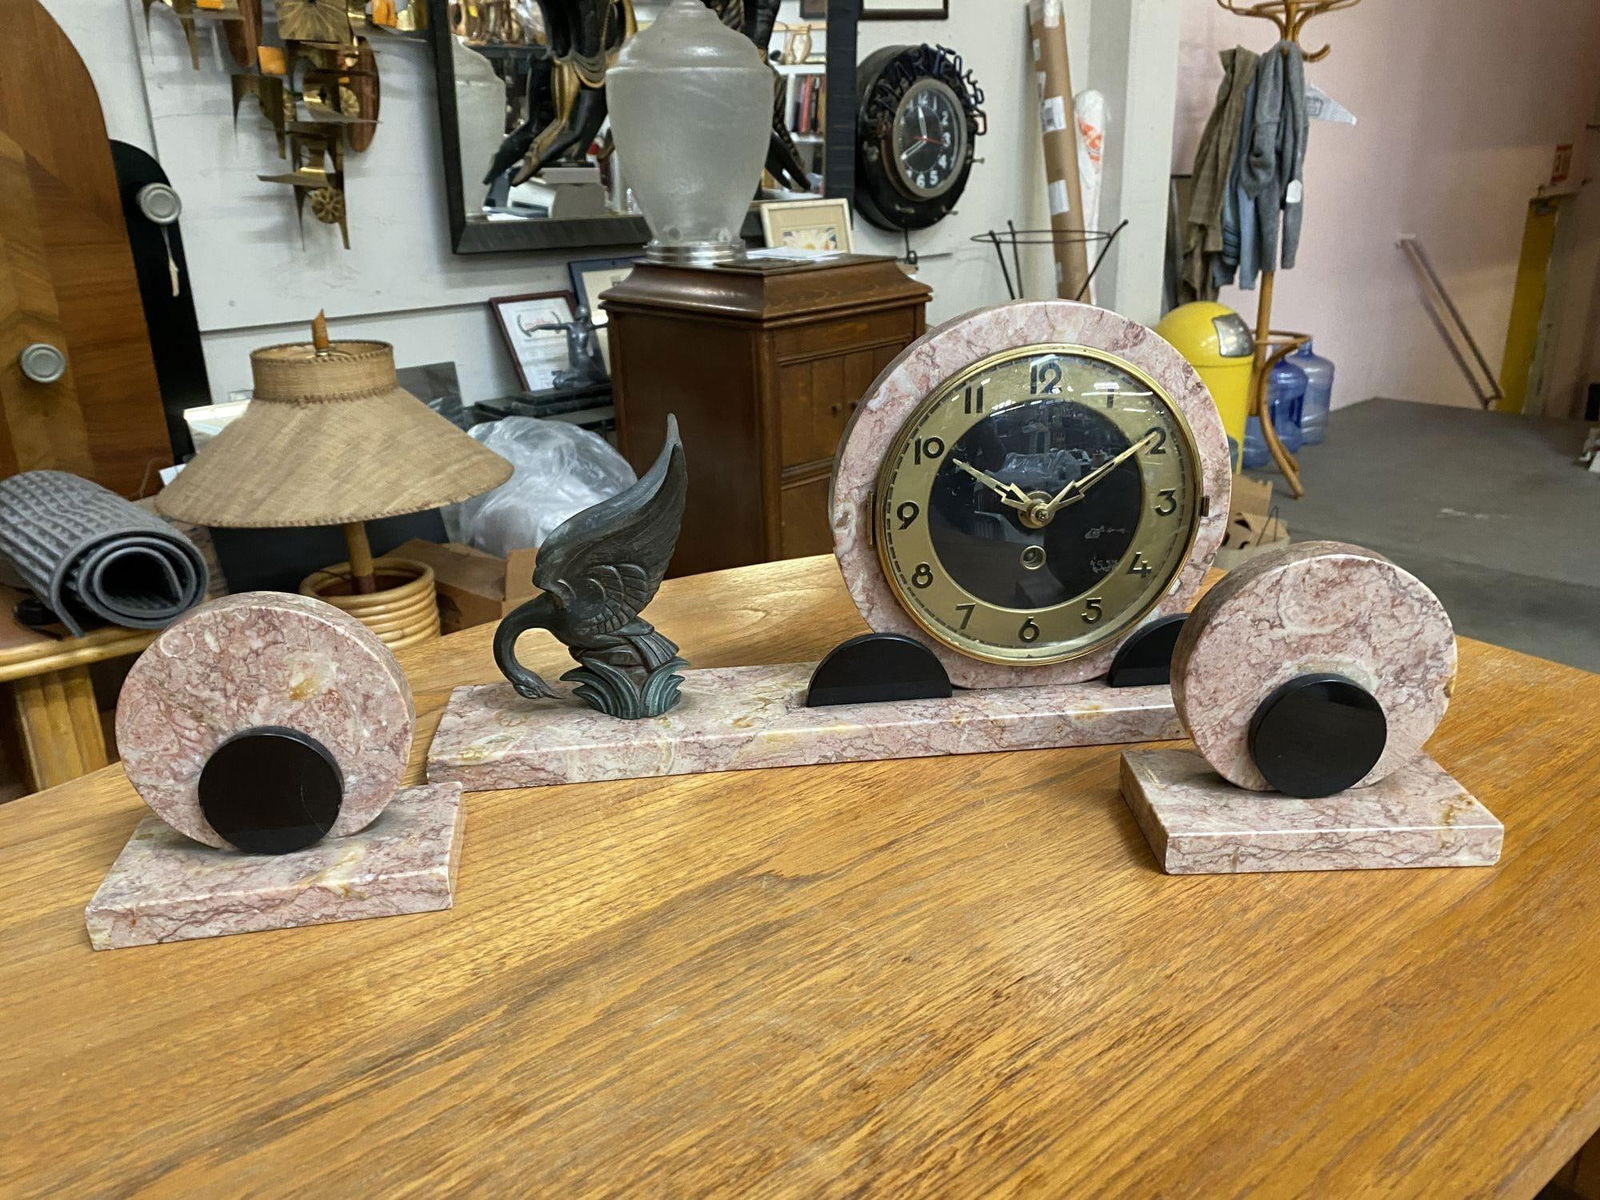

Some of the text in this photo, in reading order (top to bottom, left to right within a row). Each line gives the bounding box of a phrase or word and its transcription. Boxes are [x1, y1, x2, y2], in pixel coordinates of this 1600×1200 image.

[941, 110, 948, 126] 2
[943, 132, 951, 148] 3
[938, 154, 947, 169] 4
[916, 173, 925, 189] 6
[930, 170, 938, 185] 5
[1030, 361, 1062, 394] 12
[964, 386, 984, 414] 11
[1105, 385, 1115, 408] 1
[914, 437, 945, 465] 10
[1145, 427, 1167, 455] 2
[896, 501, 919, 530] 9
[1154, 489, 1177, 517] 3
[911, 563, 933, 589] 8
[1128, 551, 1151, 578] 4
[955, 603, 976, 630] 7
[1081, 597, 1103, 624] 5
[1018, 616, 1041, 643] 6
